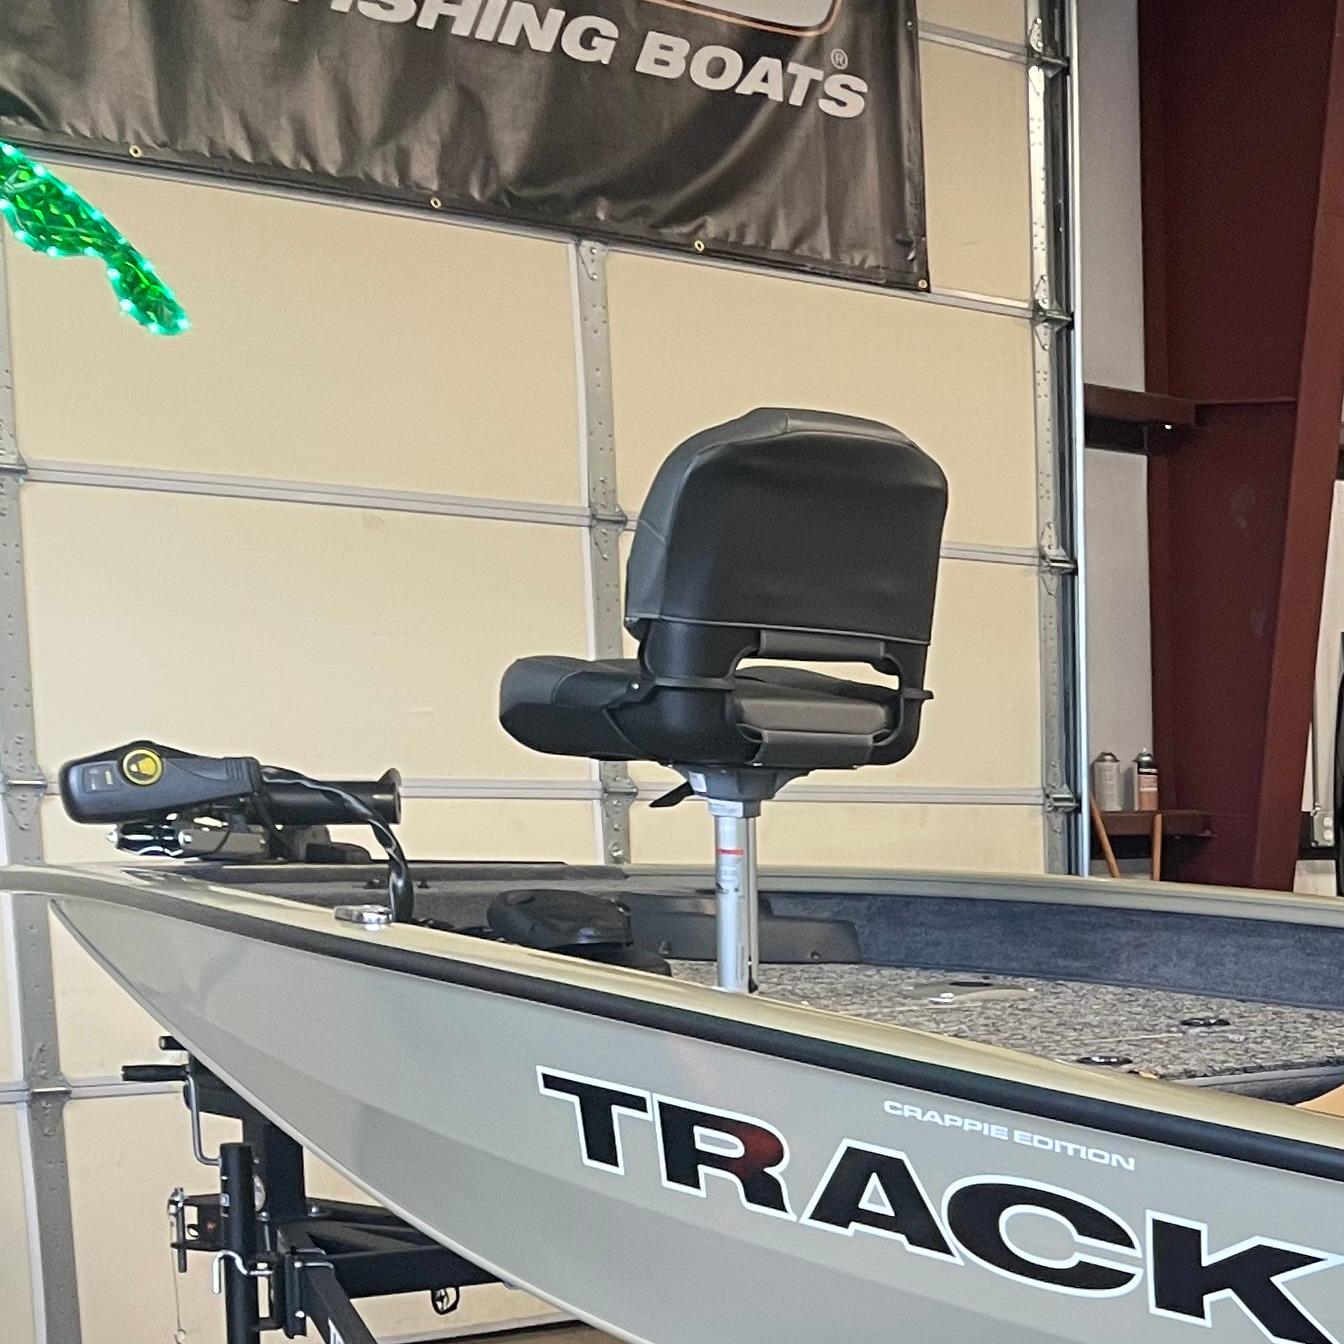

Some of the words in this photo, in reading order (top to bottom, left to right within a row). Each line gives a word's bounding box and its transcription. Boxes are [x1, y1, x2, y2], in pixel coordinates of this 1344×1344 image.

[634, 30, 870, 118] BOATS
[884, 1100, 1008, 1140] CRAPPIE
[1014, 1129, 1136, 1171] EDITION
